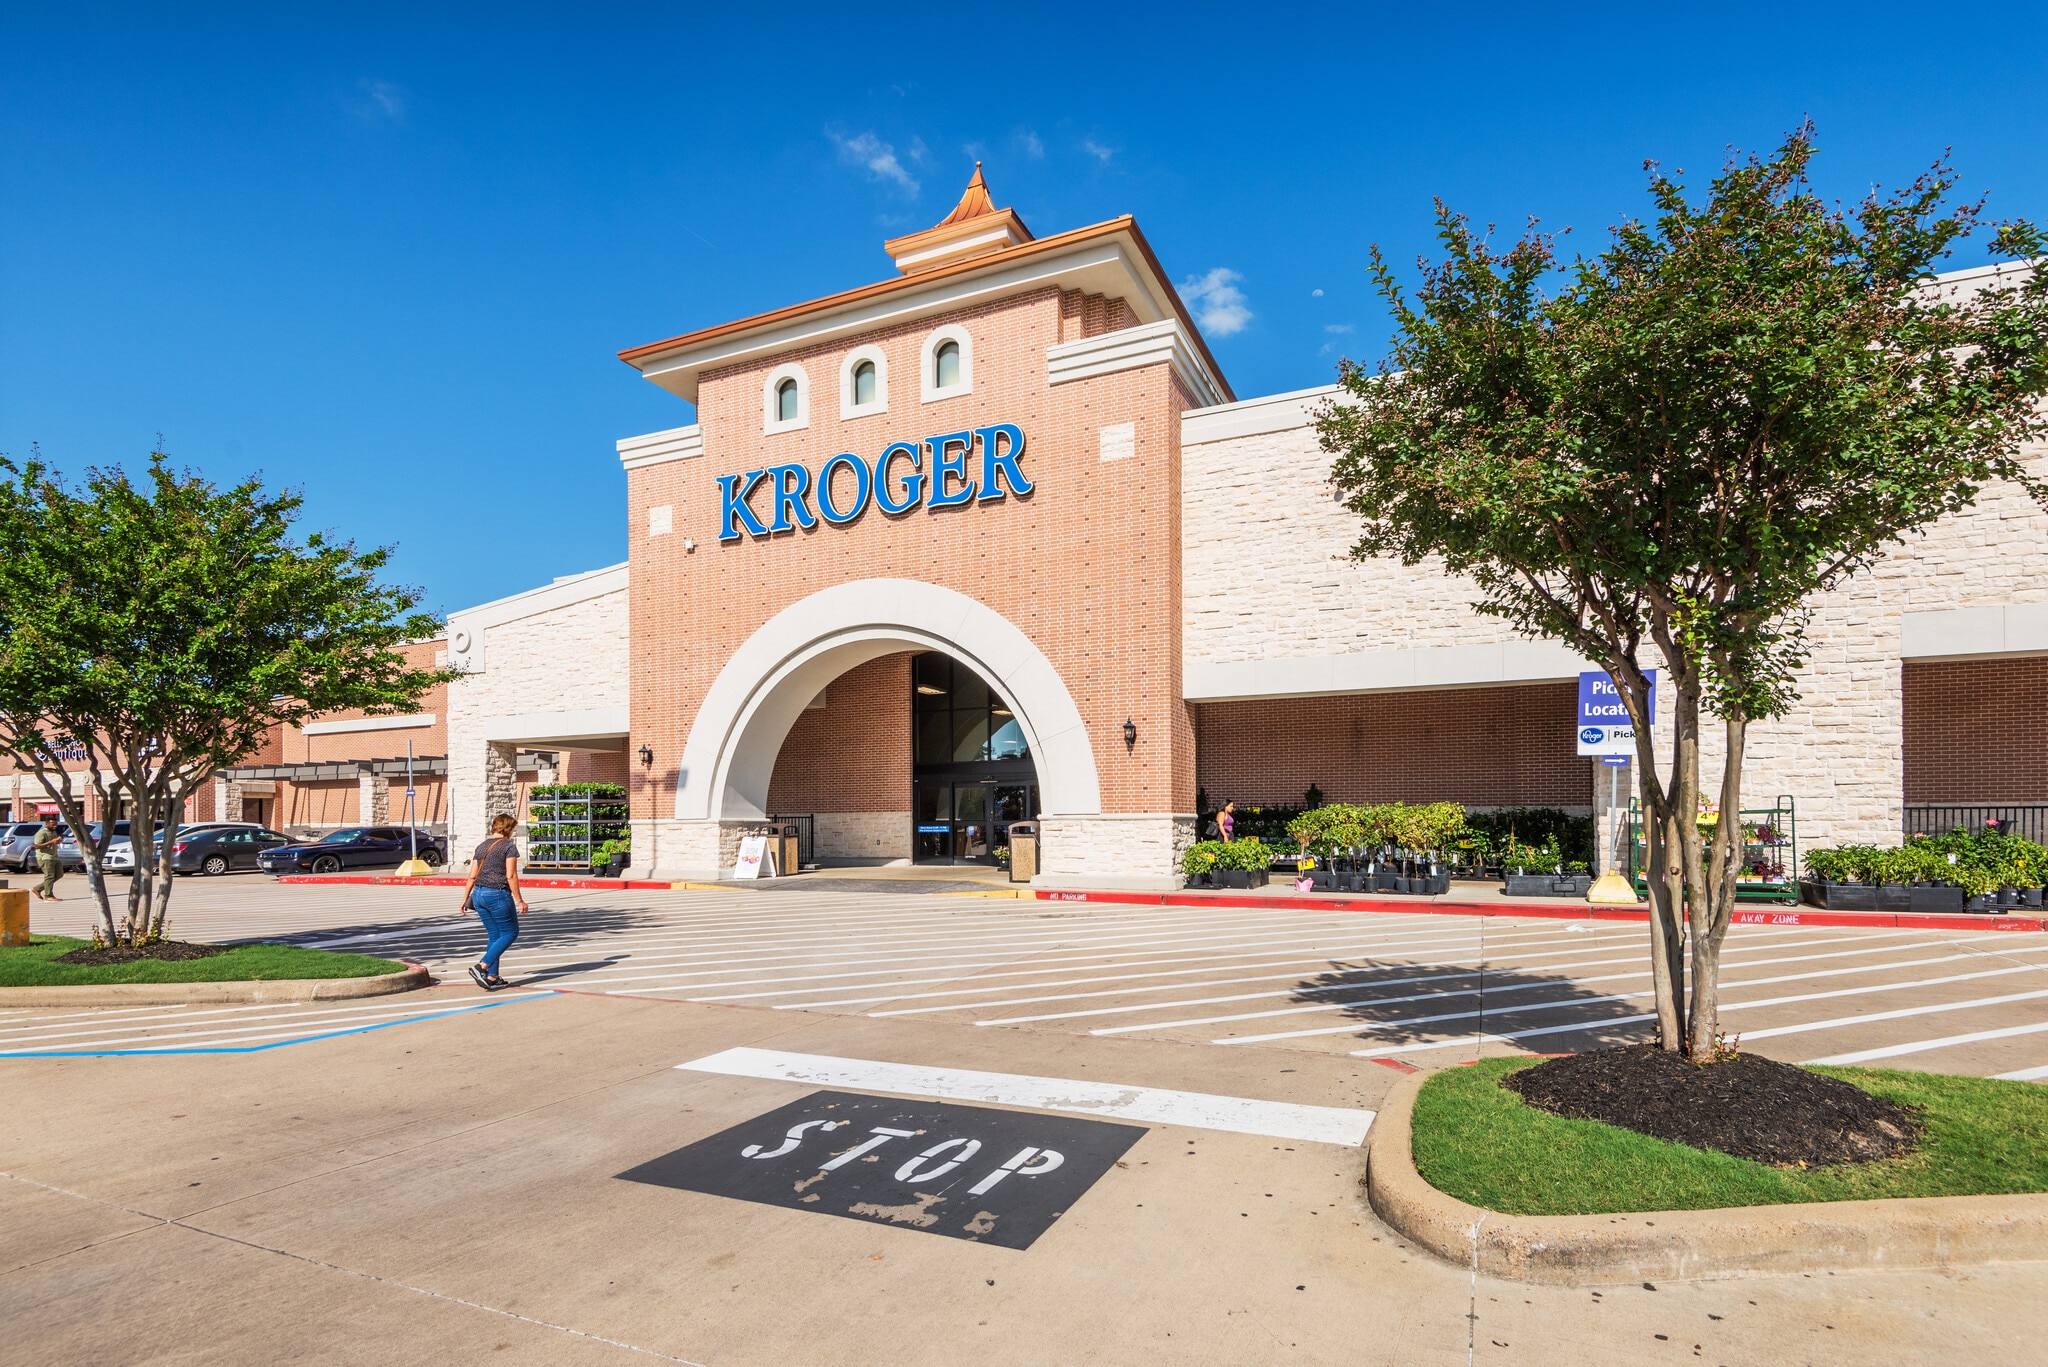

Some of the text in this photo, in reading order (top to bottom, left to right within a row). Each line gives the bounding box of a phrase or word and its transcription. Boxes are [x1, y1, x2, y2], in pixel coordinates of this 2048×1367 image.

[715, 423, 1034, 541] KROGER
[1582, 730, 1636, 742] Kroger Pick
[1050, 892, 1087, 901] NO PARKING
[1740, 914, 1765, 923] AWAY
[1771, 914, 1800, 924] ZONE
[741, 1119, 1066, 1196] STOP
